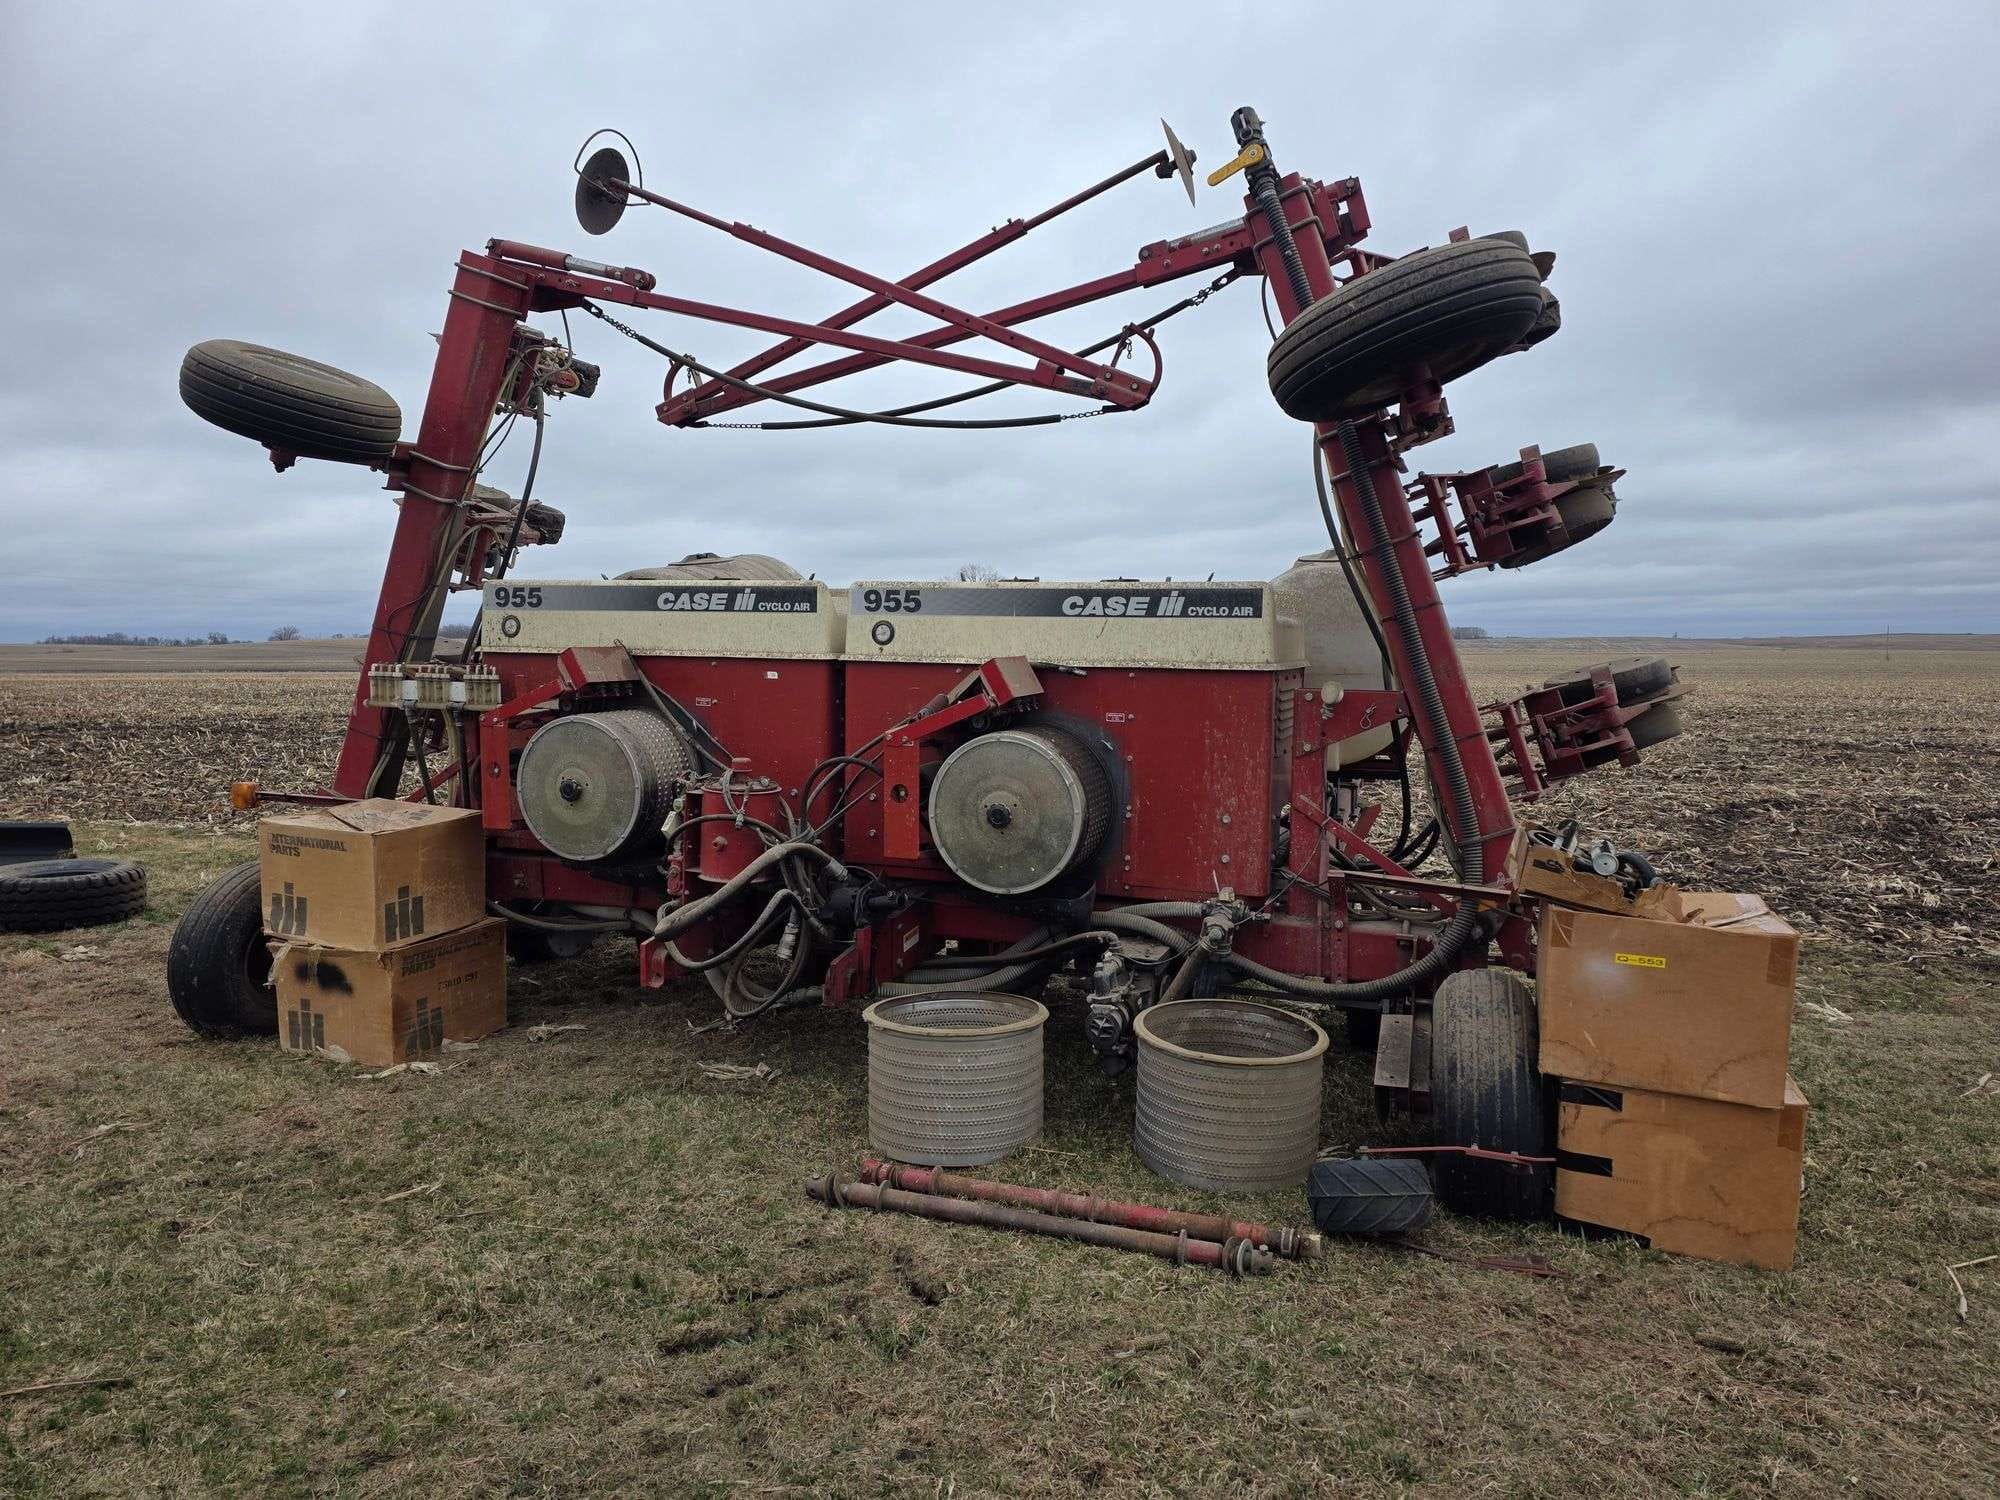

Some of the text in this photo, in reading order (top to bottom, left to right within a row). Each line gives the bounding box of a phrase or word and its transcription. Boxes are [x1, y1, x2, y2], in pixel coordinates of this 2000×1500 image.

[495, 586, 543, 608] 955
[656, 592, 728, 611] CASE
[758, 602, 791, 612] CYCLO
[794, 602, 811, 612] AIR
[863, 589, 922, 612] 955
[1061, 595, 1151, 616] CASE
[1187, 606, 1229, 617] CYCLO
[1231, 606, 1254, 617] AIR
[269, 844, 301, 857] PARTS
[1617, 955, 1664, 966] Q-553
